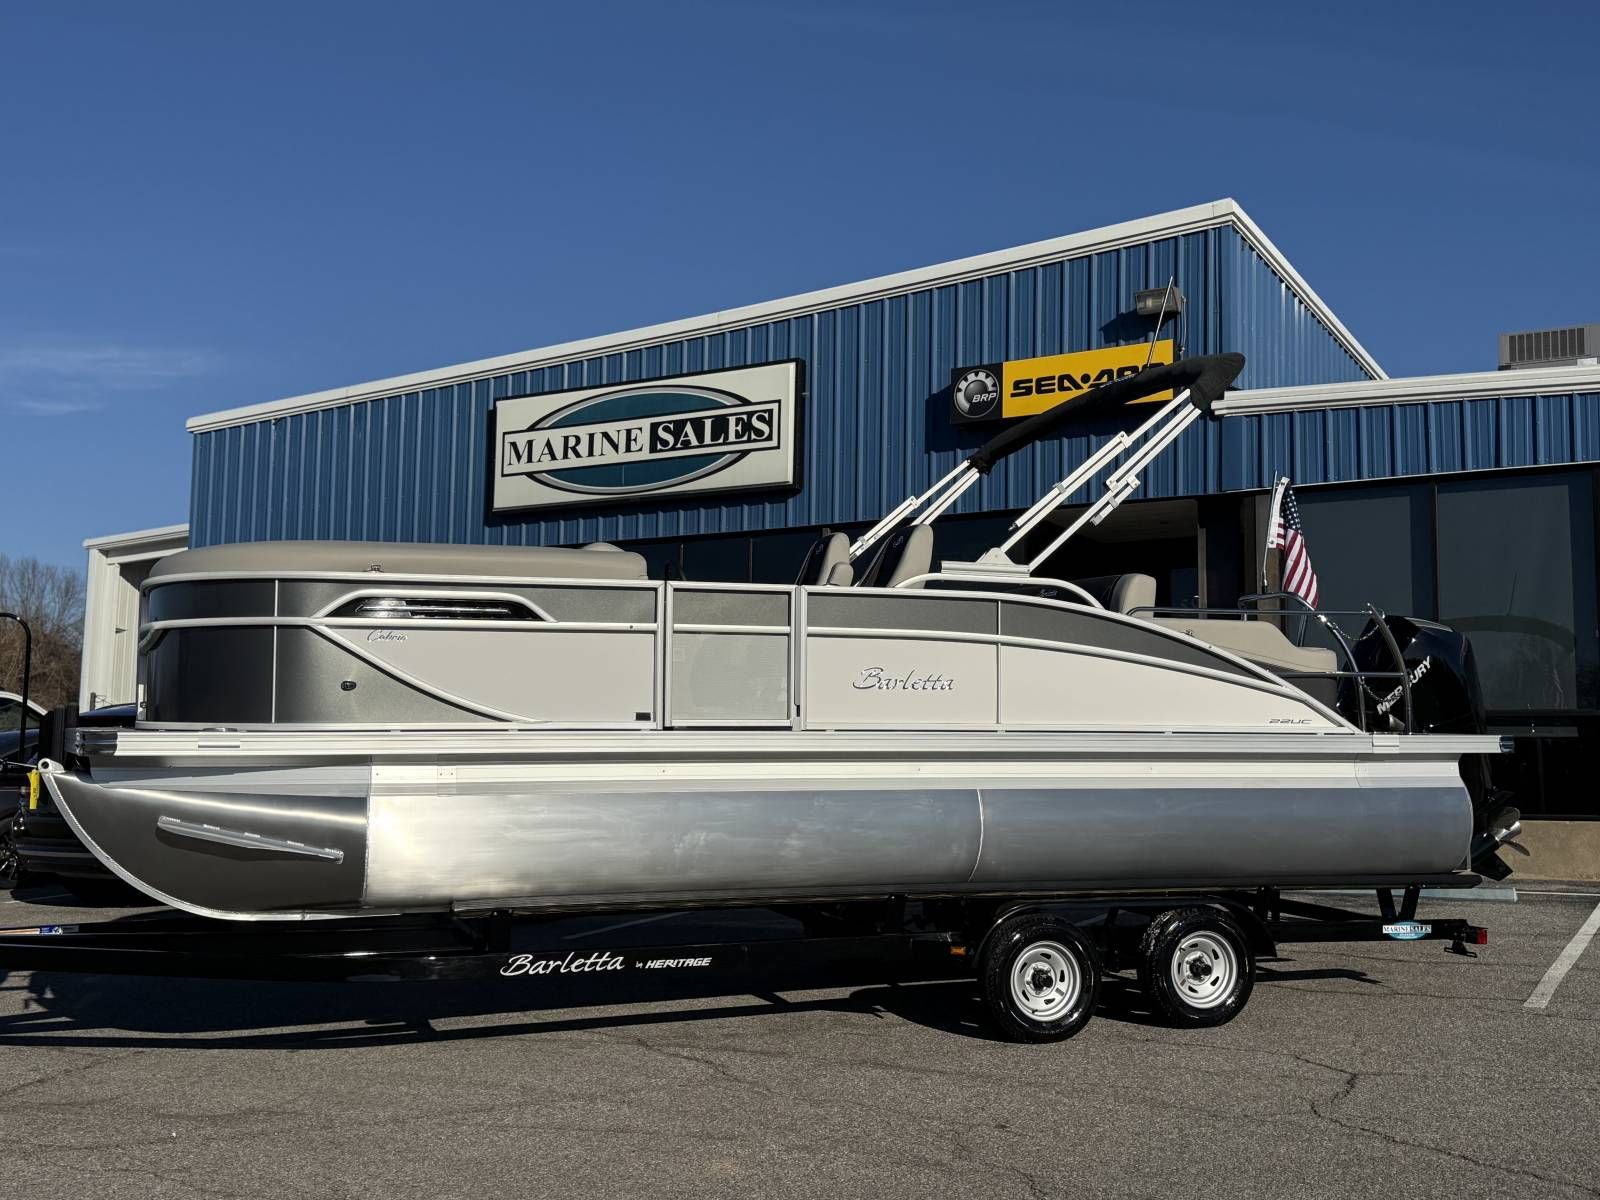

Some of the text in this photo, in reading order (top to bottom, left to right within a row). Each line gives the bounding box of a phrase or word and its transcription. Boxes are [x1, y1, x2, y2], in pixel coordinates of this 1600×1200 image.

[972, 392, 997, 403] BRP
[507, 411, 770, 466] MARINE SALES
[852, 666, 954, 691] Barletta
[500, 951, 625, 976] Barletta
[645, 957, 713, 969] HERITAGE
